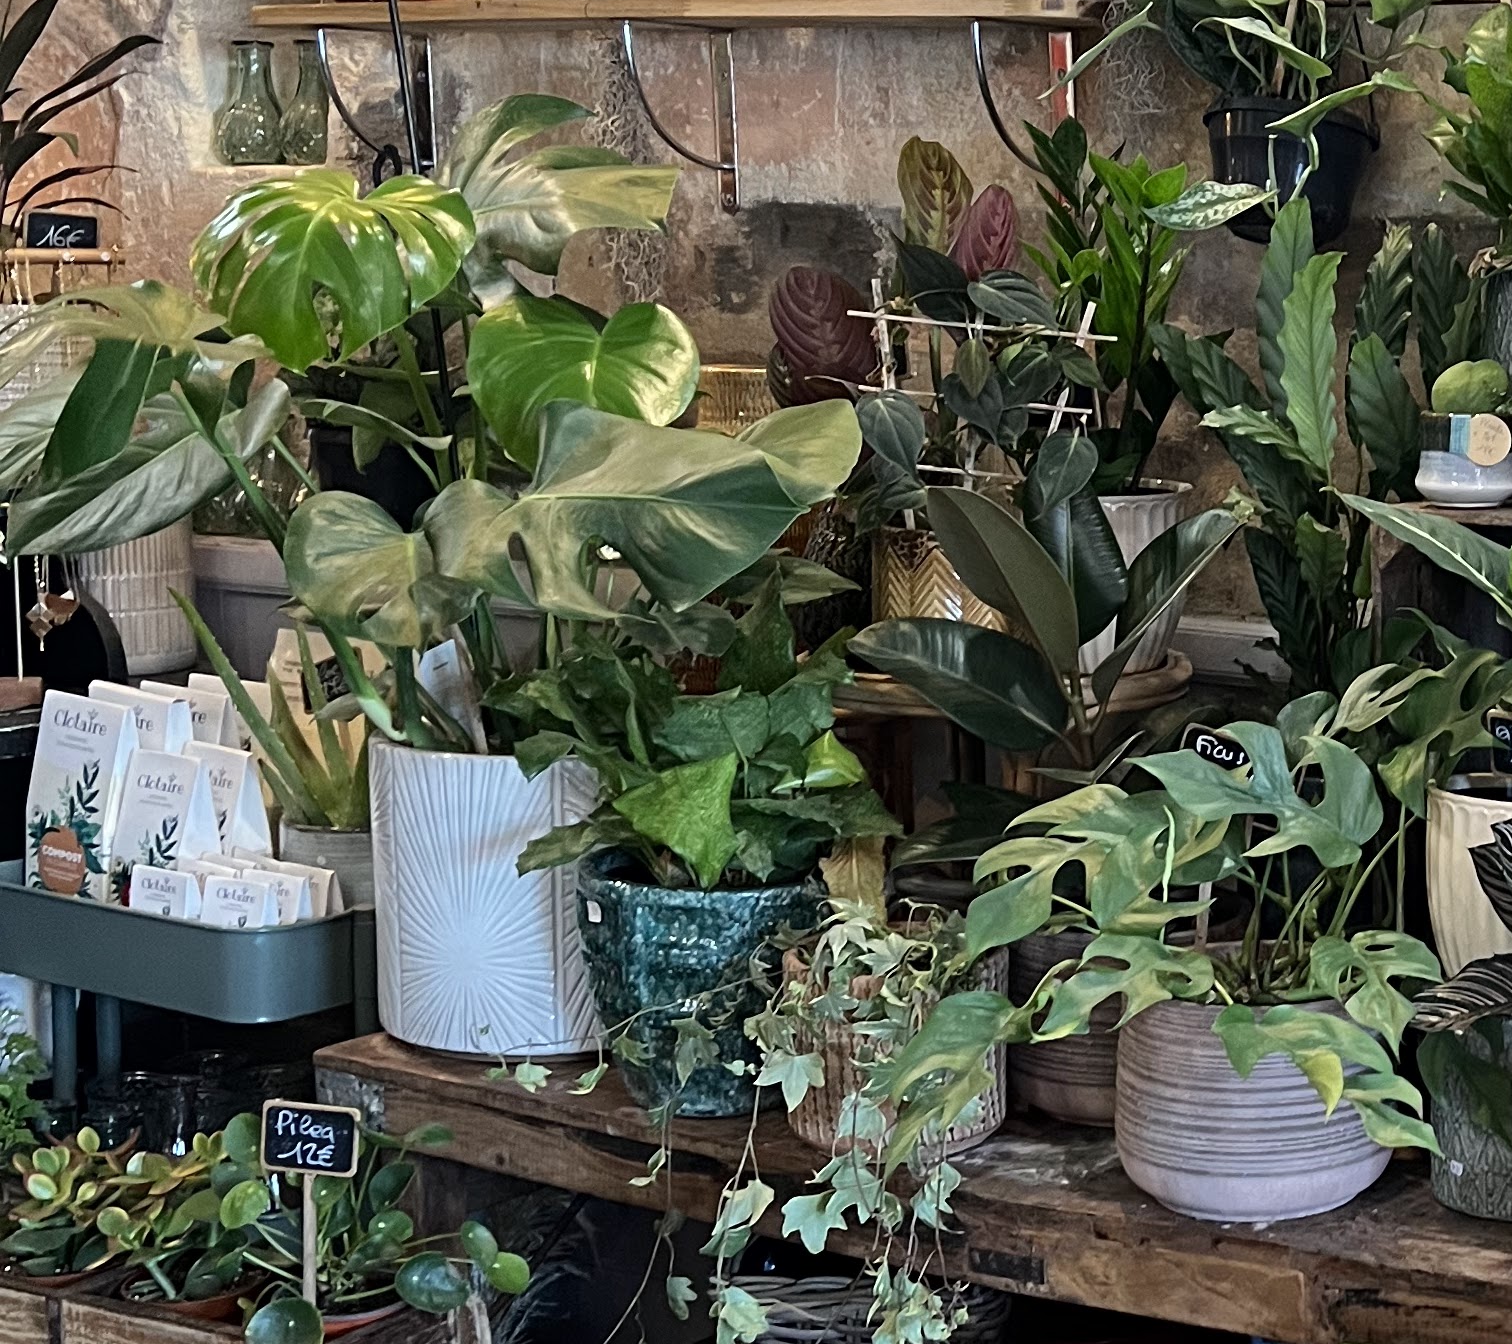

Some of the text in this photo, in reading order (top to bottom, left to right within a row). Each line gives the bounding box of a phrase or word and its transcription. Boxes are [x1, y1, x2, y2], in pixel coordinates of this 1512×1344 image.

[36, 224, 85, 248] 16€
[54, 708, 108, 736] Clotaire
[137, 772, 185, 795] Clotaire
[274, 1109, 335, 1144] Pilea
[277, 1140, 335, 1167] 12€
